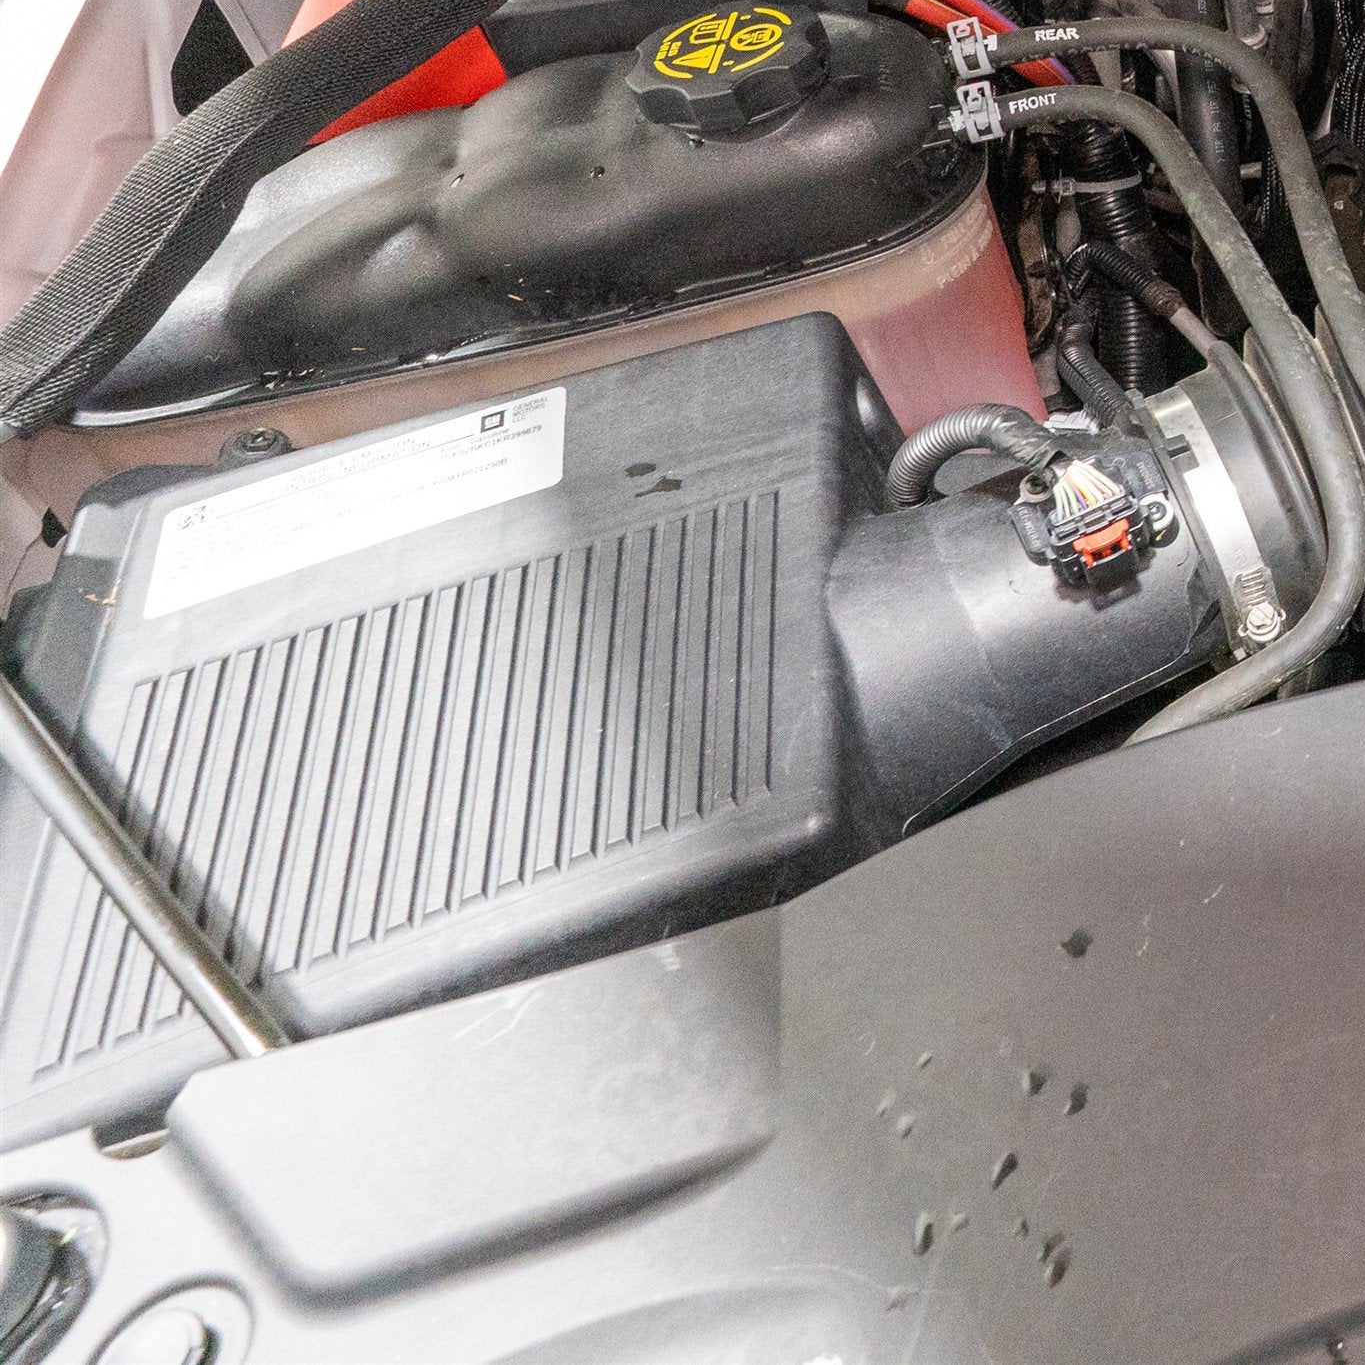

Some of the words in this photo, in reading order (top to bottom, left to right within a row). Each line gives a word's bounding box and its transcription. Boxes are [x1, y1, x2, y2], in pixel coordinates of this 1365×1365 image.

[1034, 27, 1080, 42] REAR
[1008, 93, 1057, 114] FRONT
[512, 402, 545, 417] MOTORS
[513, 395, 548, 411] GENERAL
[512, 413, 526, 423] LLC
